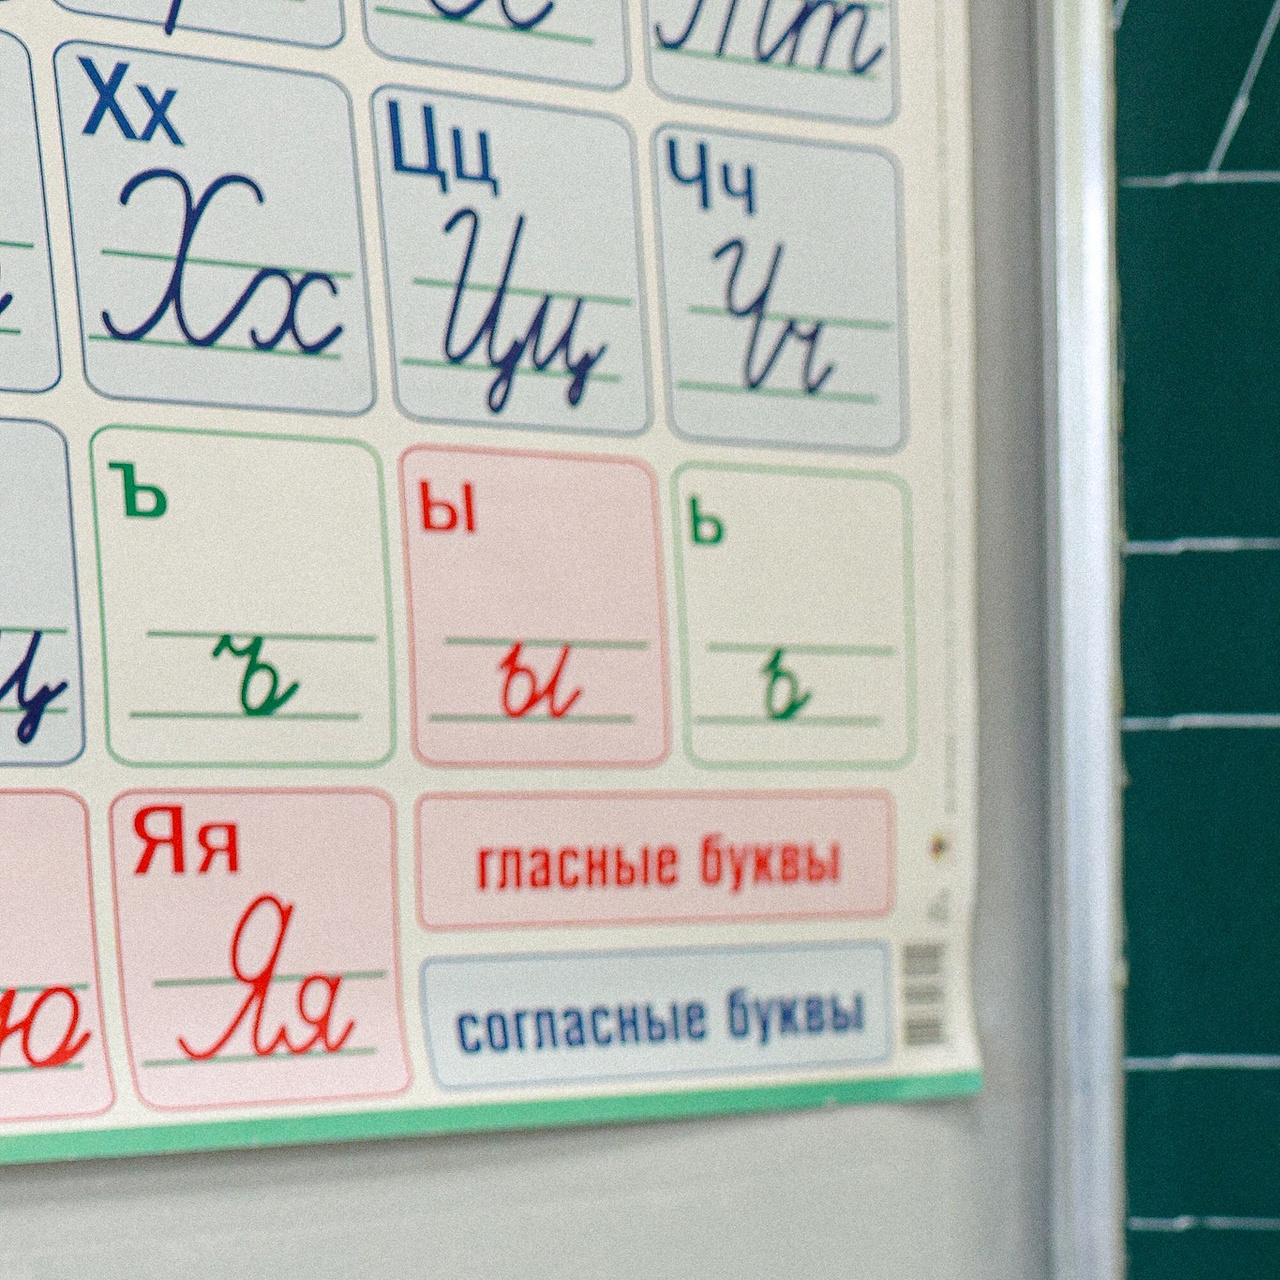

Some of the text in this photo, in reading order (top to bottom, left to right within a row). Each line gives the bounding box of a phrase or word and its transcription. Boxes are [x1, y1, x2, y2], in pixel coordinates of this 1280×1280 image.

[80, 57, 184, 146] Хх
[387, 100, 499, 195] Цц
[666, 138, 758, 214] Чч
[133, 805, 240, 876] Яя
[476, 832, 842, 893] гласные буквы
[456, 983, 867, 1056] согласные буквы
